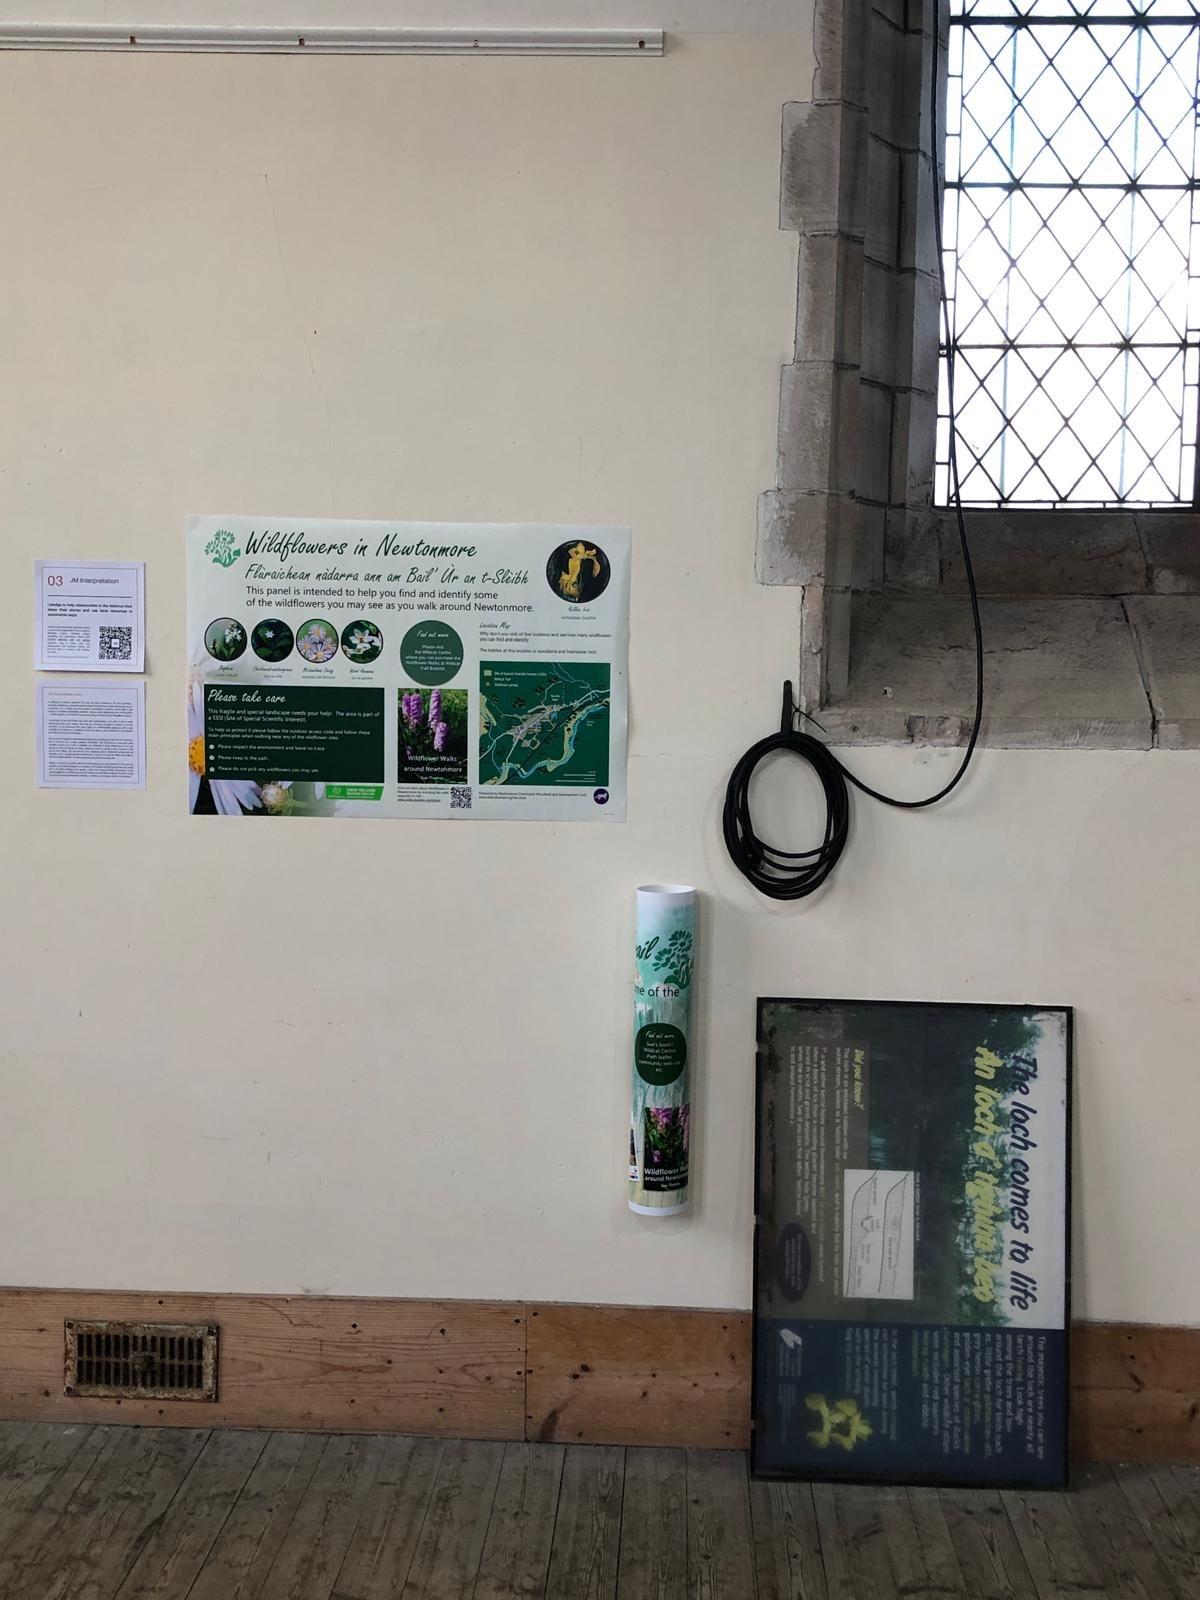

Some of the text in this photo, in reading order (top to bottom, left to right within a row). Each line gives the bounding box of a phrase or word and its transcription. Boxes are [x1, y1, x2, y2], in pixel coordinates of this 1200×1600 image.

[245, 530, 477, 562] Wildflowers in Newtonmore
[48, 575, 63, 586] 03
[245, 564, 310, 580] Flùraichean
[364, 572, 382, 582] ann
[387, 573, 401, 582] am
[463, 574, 476, 584] an
[246, 586, 264, 595] This
[267, 587, 291, 597] panel
[294, 587, 300, 595] is
[303, 587, 343, 596] intended
[358, 588, 377, 599] help
[380, 591, 396, 599] you
[399, 589, 416, 598] find
[418, 589, 435, 598] and
[438, 590, 471, 600] identify
[246, 598, 256, 606] of
[258, 598, 272, 607] the
[275, 599, 325, 608] wildflowers
[328, 601, 344, 610] you
[347, 601, 366, 611] may
[398, 603, 414, 612] you
[416, 602, 436, 610] walk
[440, 602, 471, 611] around
[474, 603, 534, 612] Newtonmore.
[208, 689, 238, 702] Please
[241, 690, 262, 702] take
[648, 986, 660, 997] of
[663, 986, 680, 997] the
[974, 1047, 1004, 1079] An
[852, 1049, 864, 1110] Did you know?
[973, 1084, 1002, 1136] loch
[1009, 1055, 1038, 1311] The loch comes to life
